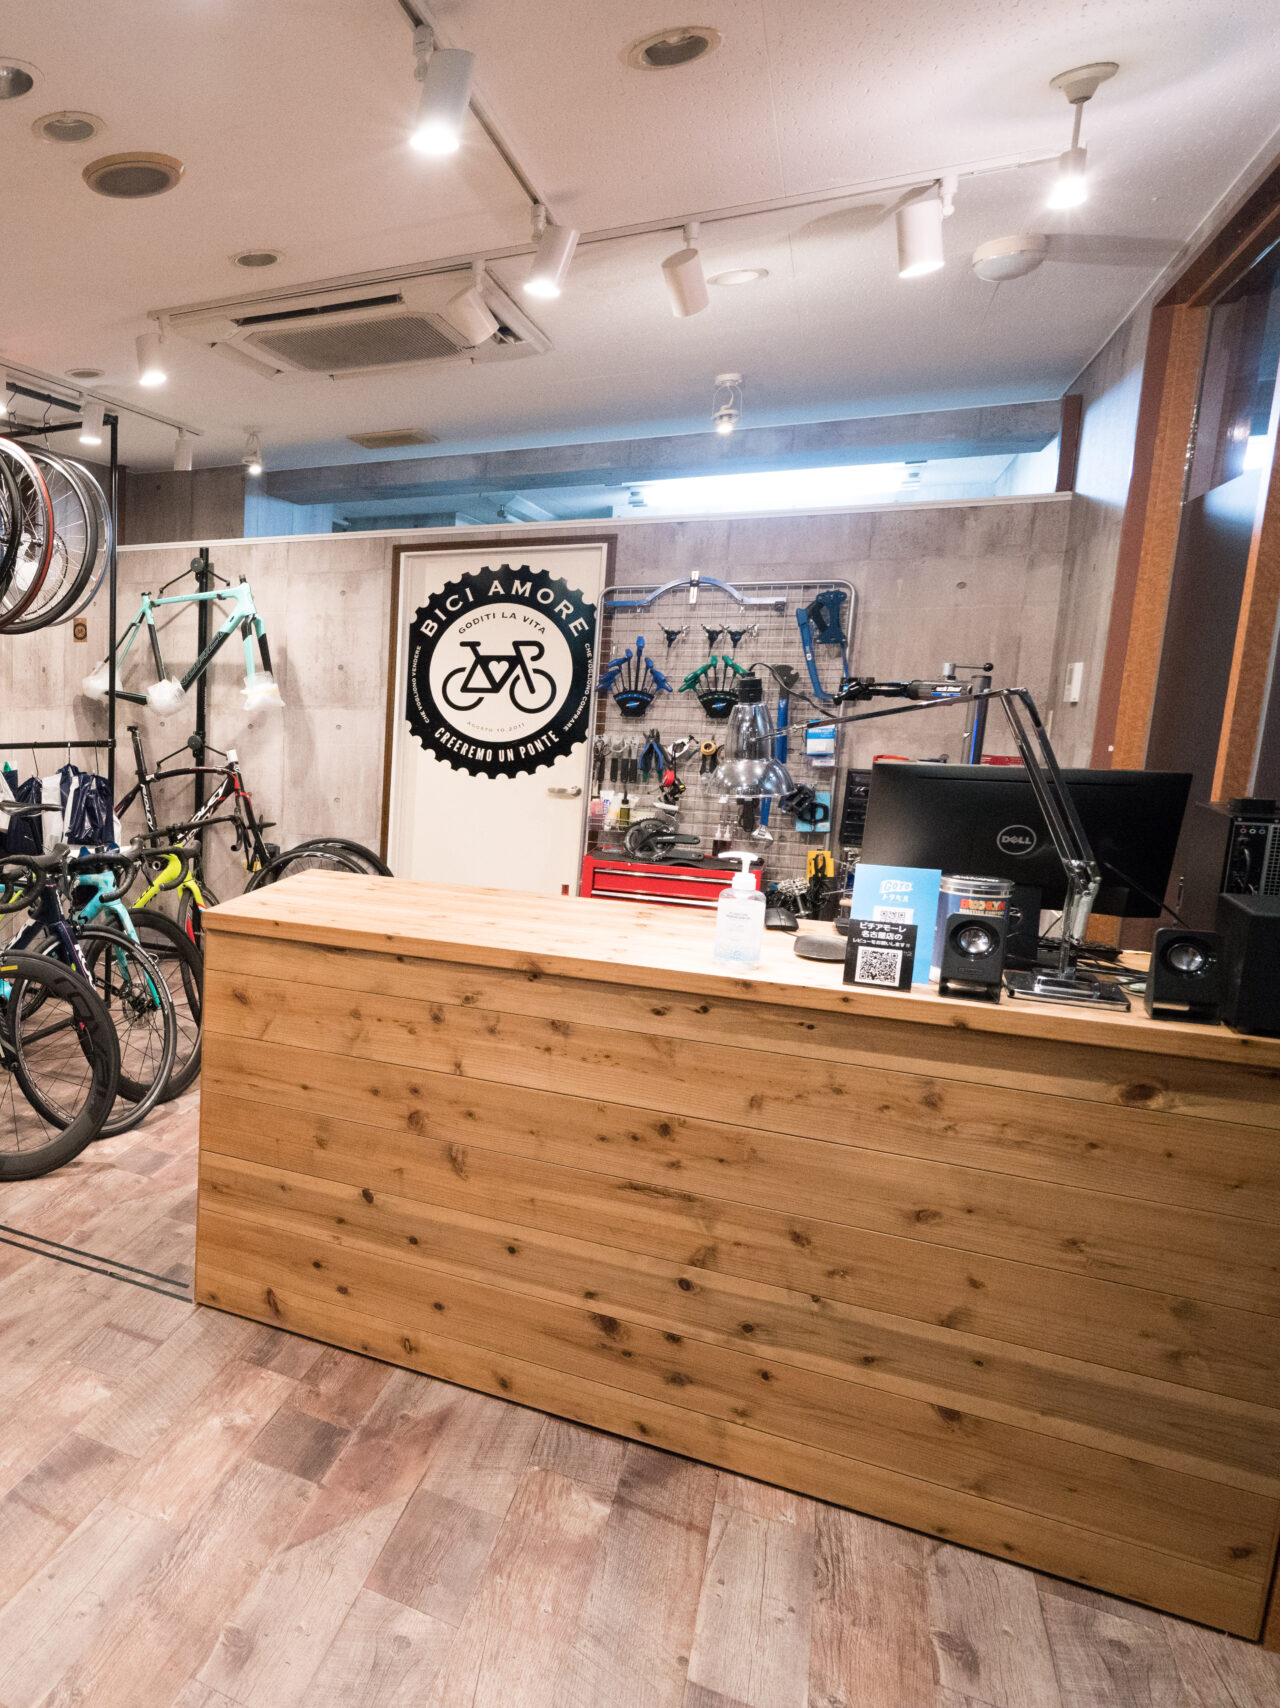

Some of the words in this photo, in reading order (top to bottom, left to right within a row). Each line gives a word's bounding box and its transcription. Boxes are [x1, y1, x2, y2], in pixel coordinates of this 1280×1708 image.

[420, 587, 474, 638] BICI
[488, 579, 590, 638] AMORE
[458, 612, 496, 635] GODITI
[501, 611, 517, 620] LA
[522, 615, 546, 635] VITA
[584, 642, 593, 658] CHE
[584, 658, 593, 695] VOGLIONO
[434, 727, 493, 762] CREEREMO
[498, 749, 515, 762] UN
[520, 730, 560, 759] PONTE
[1001, 835, 1032, 845] DELL
[859, 921, 908, 933] ビチアモーレ
[861, 930, 903, 941] 名古屋店の
